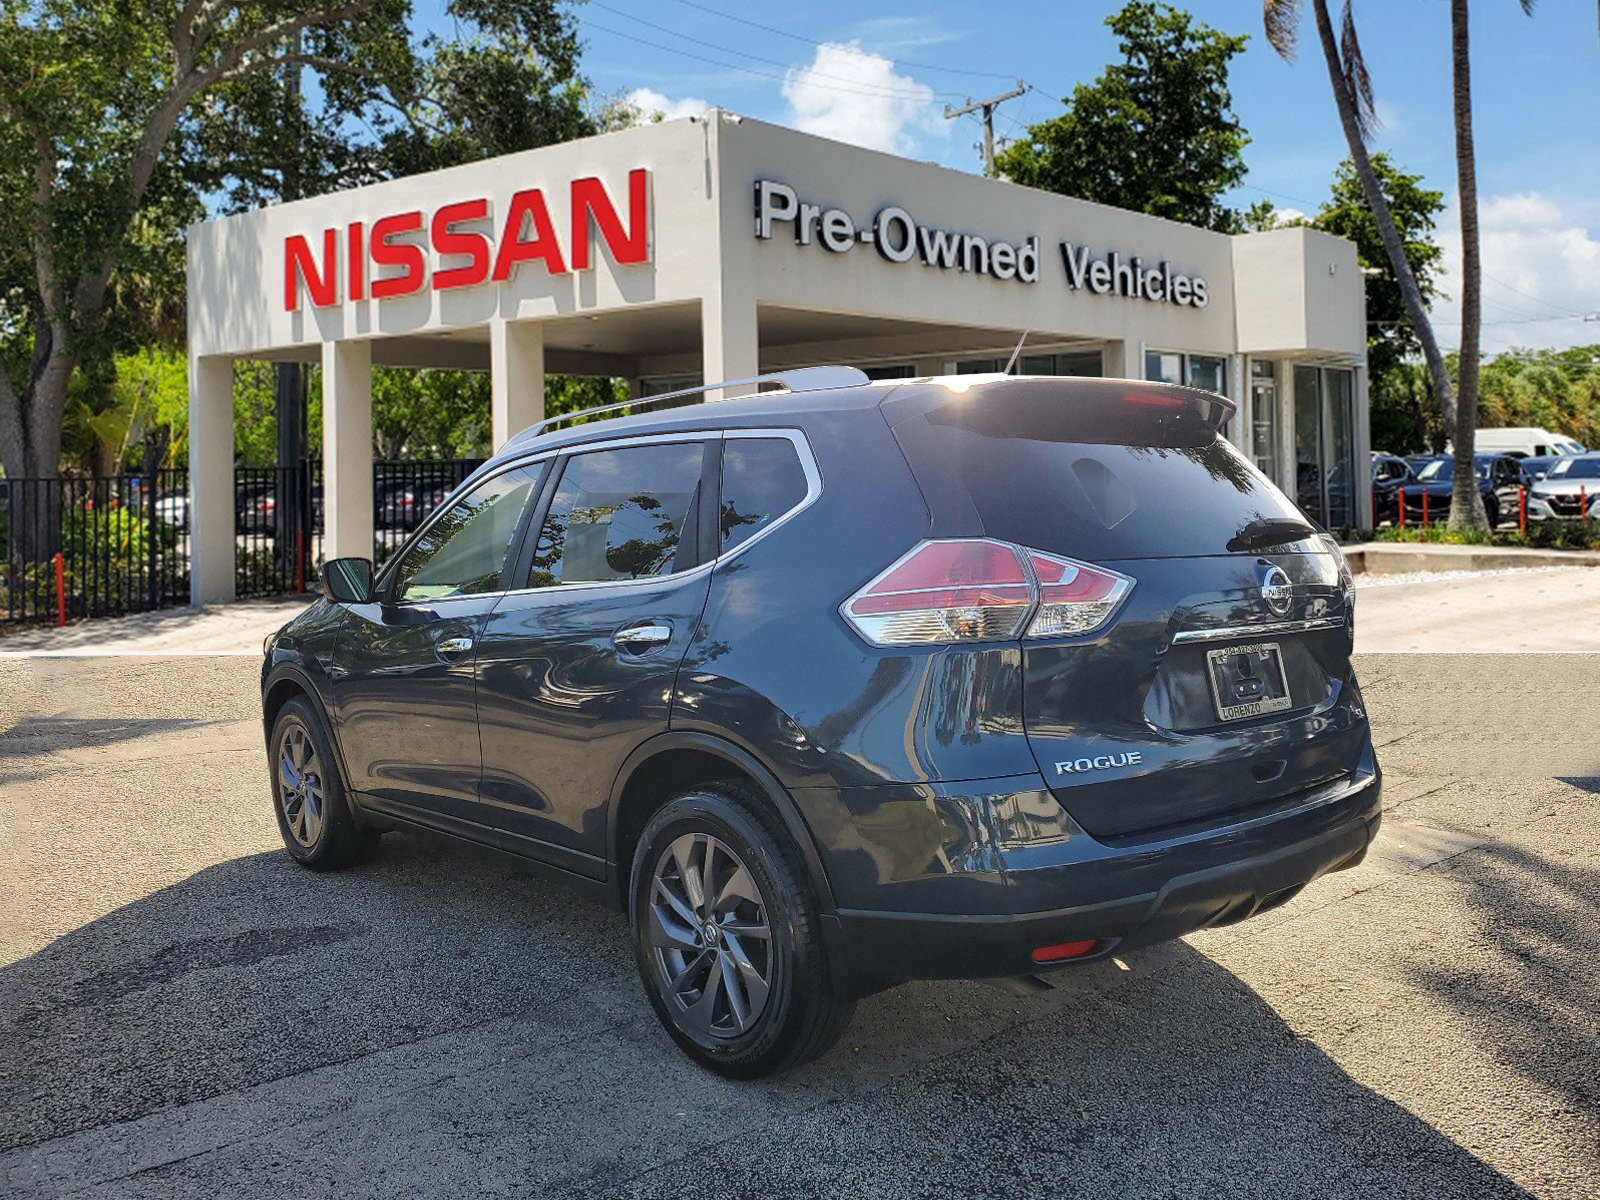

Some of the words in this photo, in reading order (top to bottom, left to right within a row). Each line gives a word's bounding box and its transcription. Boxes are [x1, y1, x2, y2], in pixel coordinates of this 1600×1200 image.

[284, 168, 649, 312] NISSAN
[755, 179, 1040, 284] Pre-Owned
[1060, 241, 1208, 308] Vehicles
[1222, 702, 1261, 719] LORENZO
[1054, 751, 1142, 775] ROGUE
